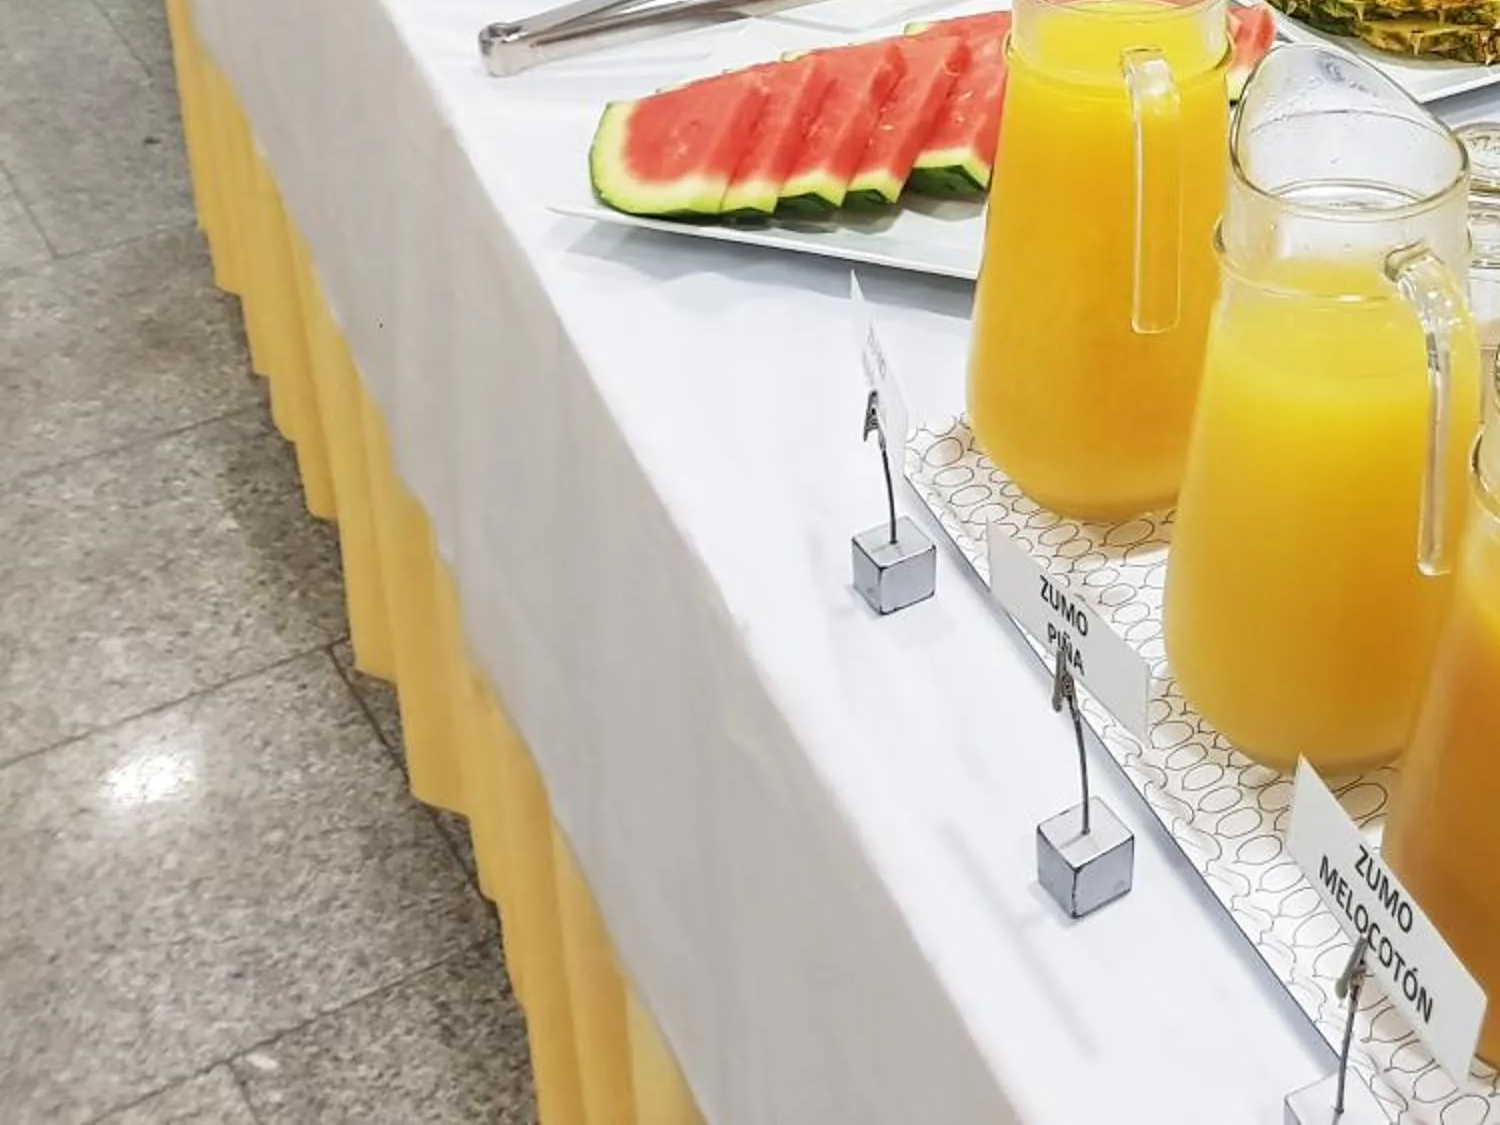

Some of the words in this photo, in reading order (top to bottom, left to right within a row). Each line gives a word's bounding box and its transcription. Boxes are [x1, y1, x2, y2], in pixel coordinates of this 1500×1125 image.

[1040, 574, 1088, 637] ZUMO
[1354, 844, 1413, 934] ZUMO
[1319, 855, 1433, 1023] MELOCOTÓN
